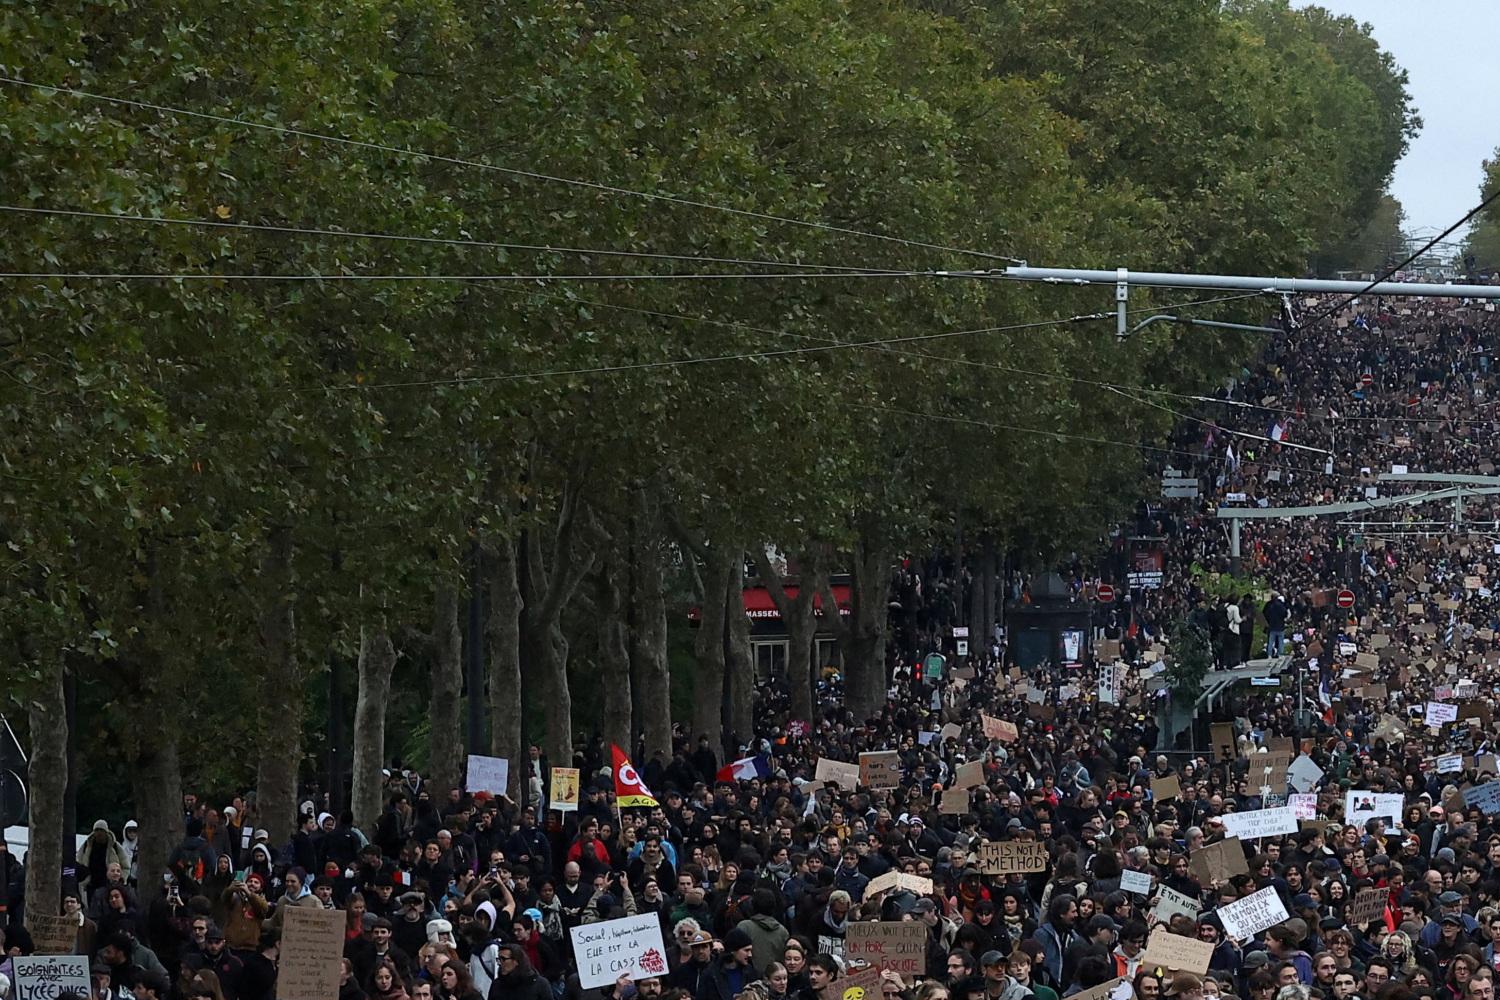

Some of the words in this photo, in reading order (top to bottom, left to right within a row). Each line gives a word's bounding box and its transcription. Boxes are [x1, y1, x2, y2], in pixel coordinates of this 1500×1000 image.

[983, 844, 1012, 857] THIS
[1016, 845, 1034, 856] NOT
[987, 857, 1043, 871] METHOD
[1231, 913, 1241, 924] EN
[1241, 907, 1255, 920] MON
[1257, 901, 1270, 912] EX
[609, 948, 621, 959] EST
[629, 943, 639, 955] LA
[848, 941, 862, 954] UN
[591, 965, 602, 978] LA
